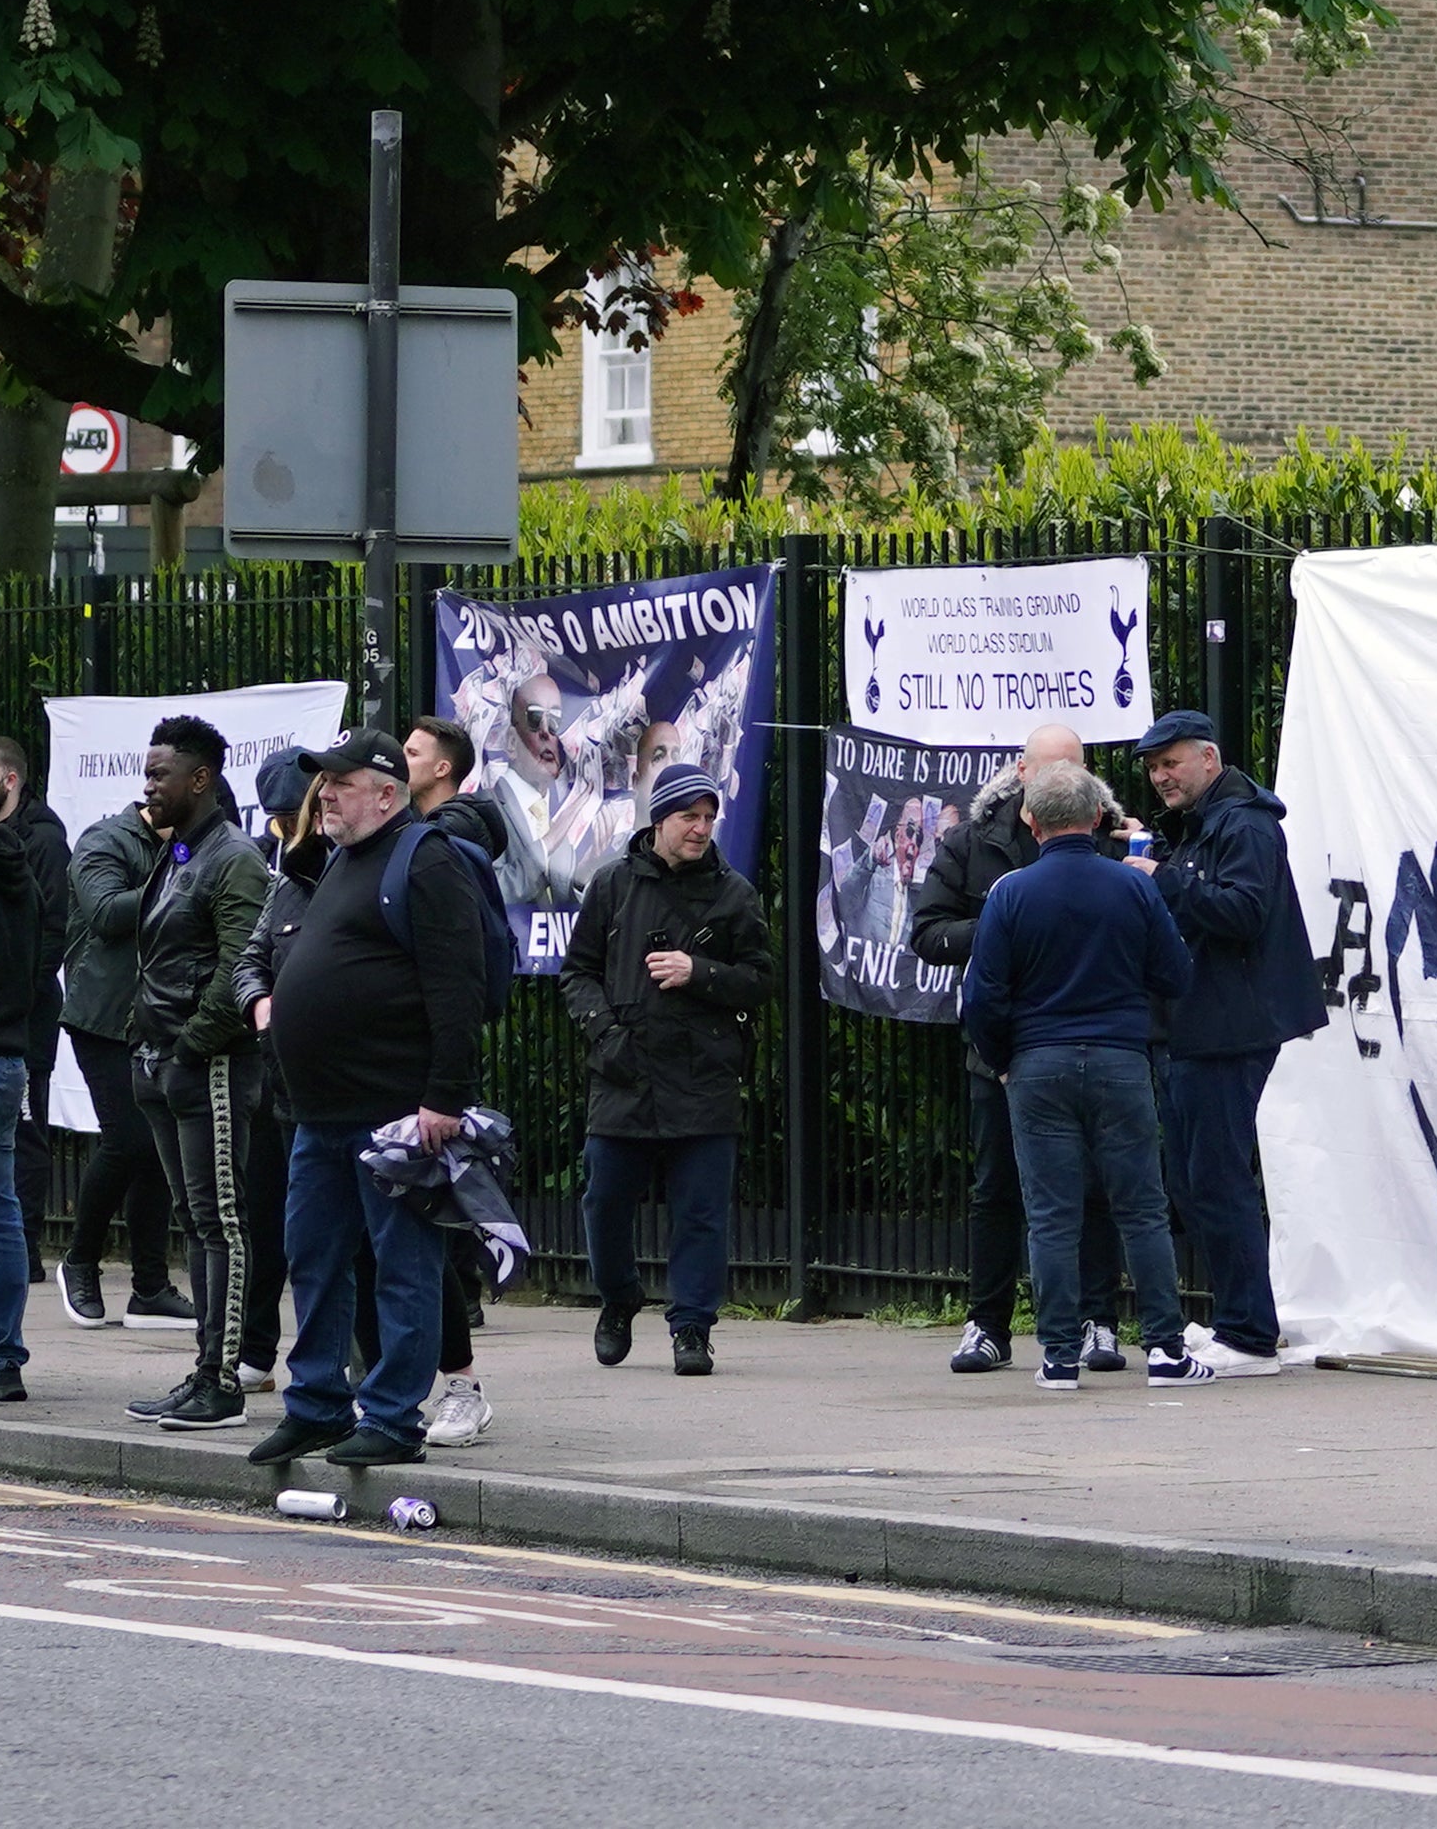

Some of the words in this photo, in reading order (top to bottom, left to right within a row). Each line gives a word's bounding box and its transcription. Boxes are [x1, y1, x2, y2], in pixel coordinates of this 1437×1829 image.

[452, 605, 495, 654] 20
[591, 582, 757, 651] AMBITION
[900, 596, 940, 618] WORLD
[943, 596, 977, 618] CLASS
[979, 595, 1024, 618] TRAINING
[1025, 592, 1081, 618] GROUND
[926, 632, 967, 655] WORLD
[969, 631, 1006, 655] CLASS
[1007, 631, 1054, 655] STADIUM
[899, 673, 948, 712] STILL
[956, 673, 986, 712] NO
[992, 669, 1096, 712] TROPHIES
[78, 754, 105, 778] THEY
[835, 734, 857, 772] TO
[862, 738, 907, 782] DARE
[913, 749, 932, 784] IS
[937, 751, 973, 786] TOO
[847, 935, 906, 991] ENIC
